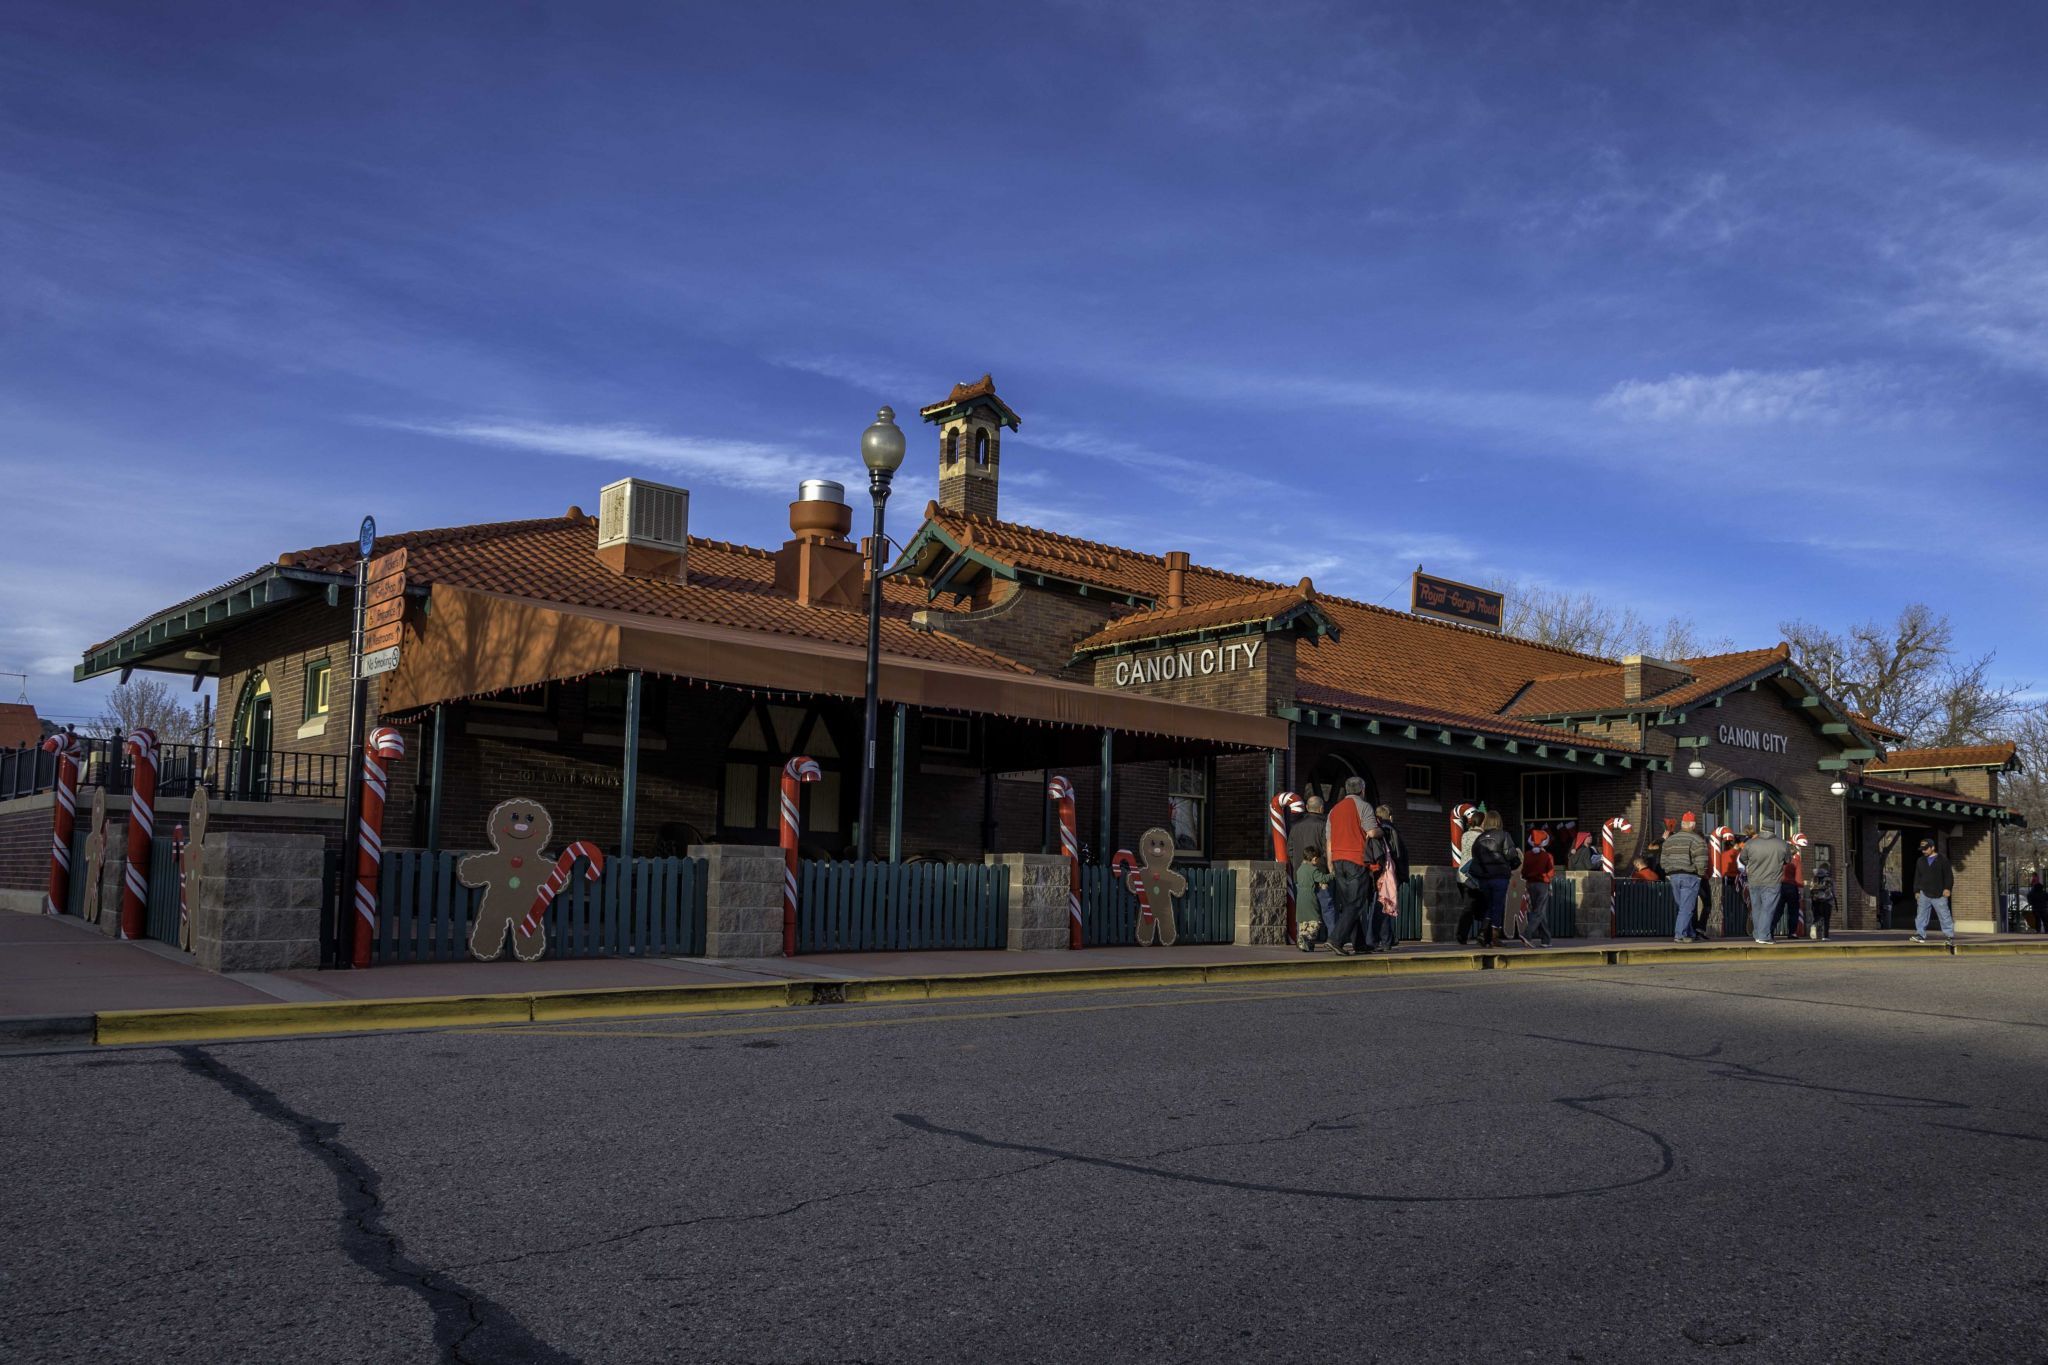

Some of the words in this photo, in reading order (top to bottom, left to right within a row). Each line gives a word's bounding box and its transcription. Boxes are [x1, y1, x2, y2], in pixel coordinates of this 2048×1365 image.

[1419, 583, 1447, 606] Royal
[1448, 592, 1476, 614] Gorge
[374, 656, 392, 670] Smoking
[1115, 651, 1194, 686] CANON
[1201, 641, 1262, 675] CITY
[1719, 724, 1760, 750] CANON
[1762, 733, 1788, 754] CITY
